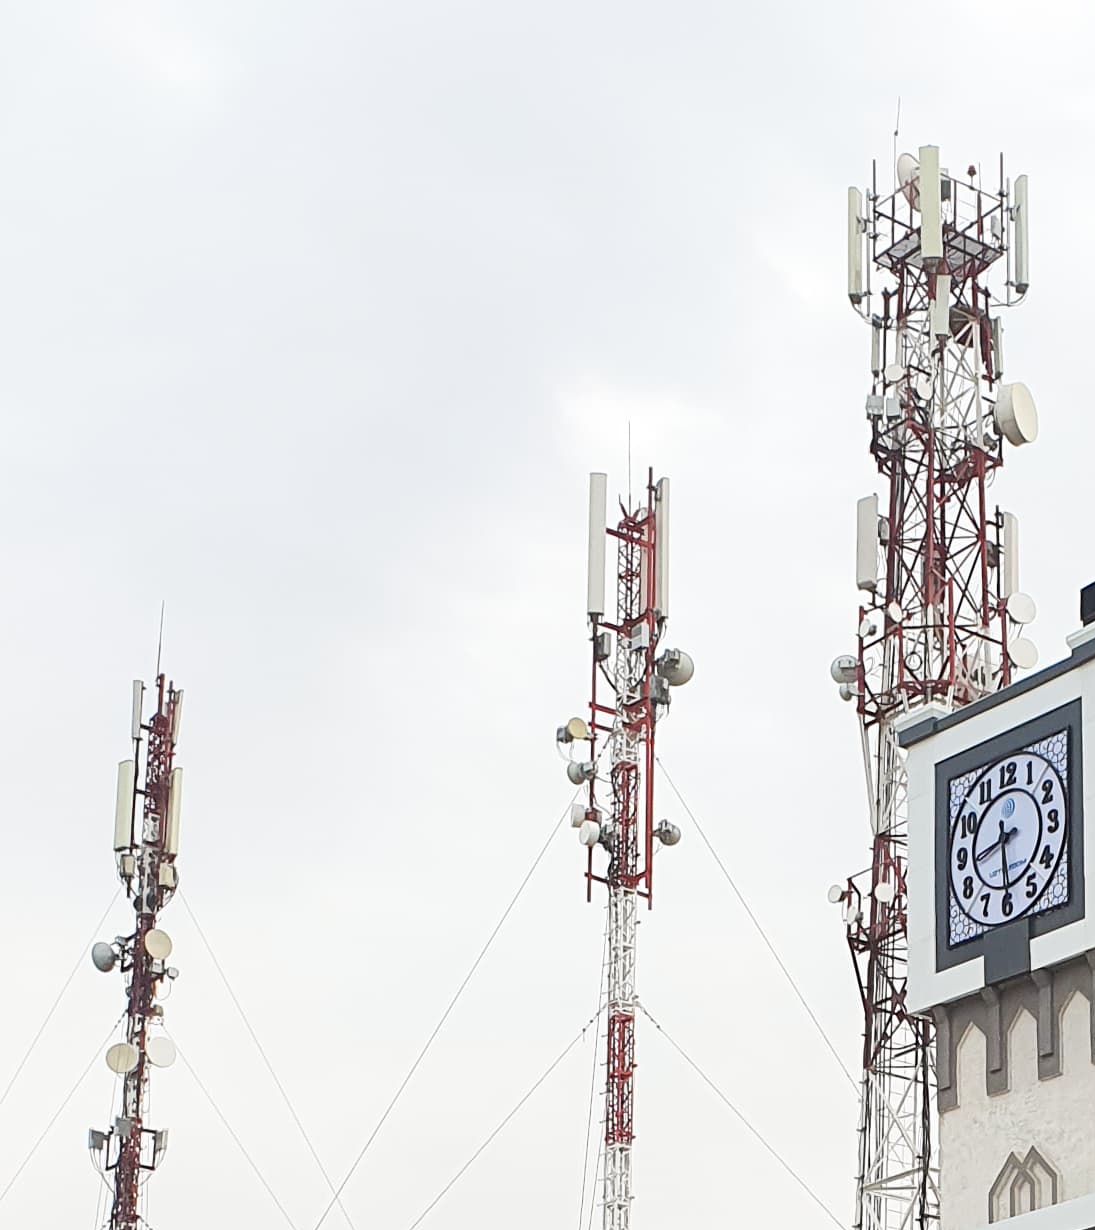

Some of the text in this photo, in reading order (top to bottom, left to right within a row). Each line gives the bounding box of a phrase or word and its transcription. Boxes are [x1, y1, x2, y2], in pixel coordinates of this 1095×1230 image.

[999, 761, 1017, 789] 12
[1026, 761, 1033, 785] 1
[979, 778, 992, 805] 11
[1042, 779, 1053, 804] 2
[961, 811, 977, 839] 10
[1047, 809, 1060, 833] 3
[957, 847, 968, 871] 9
[1039, 844, 1054, 869] 4
[963, 876, 973, 899] 8
[1026, 872, 1037, 898] 5
[980, 893, 991, 917] 7
[1001, 892, 1013, 917] 6
